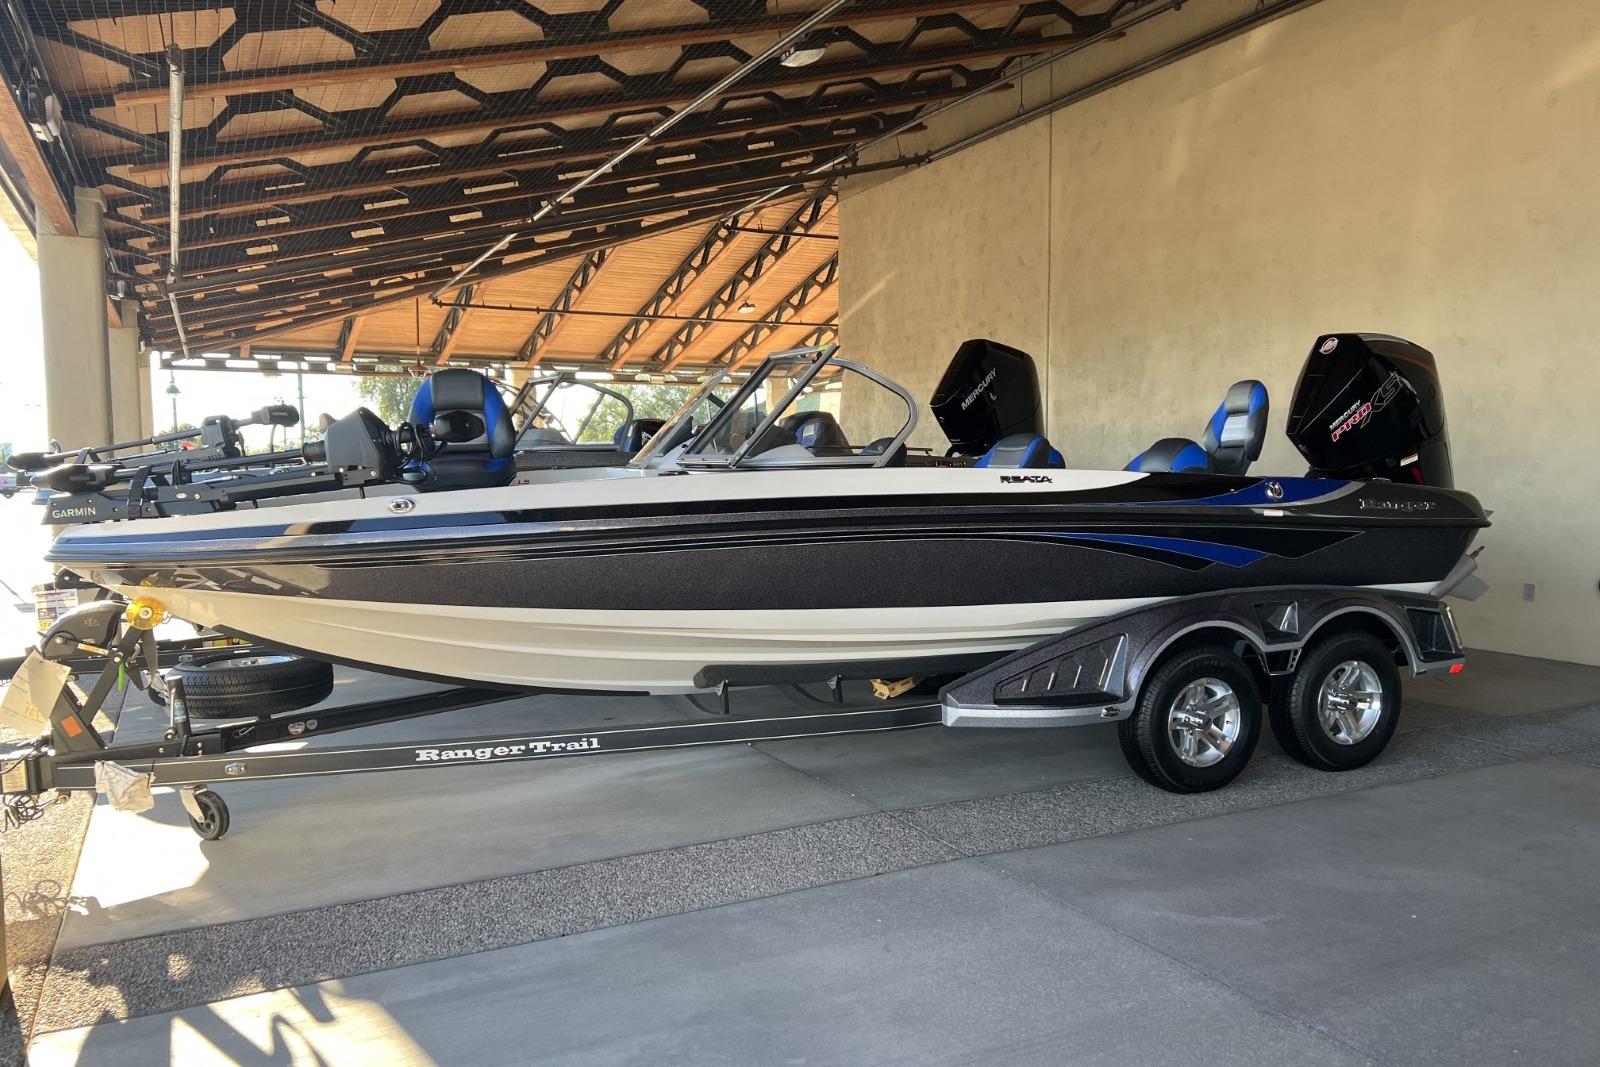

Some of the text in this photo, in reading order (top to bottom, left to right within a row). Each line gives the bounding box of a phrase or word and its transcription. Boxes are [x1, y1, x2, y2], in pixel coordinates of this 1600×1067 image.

[961, 367, 997, 411] MERCURY
[1329, 399, 1361, 431] MERCURY
[1331, 402, 1372, 442] PRO
[999, 475, 1053, 484] REATA
[52, 506, 97, 519] GARMIN
[1359, 498, 1437, 513] Ranger
[415, 737, 601, 762] Ranger Trail
